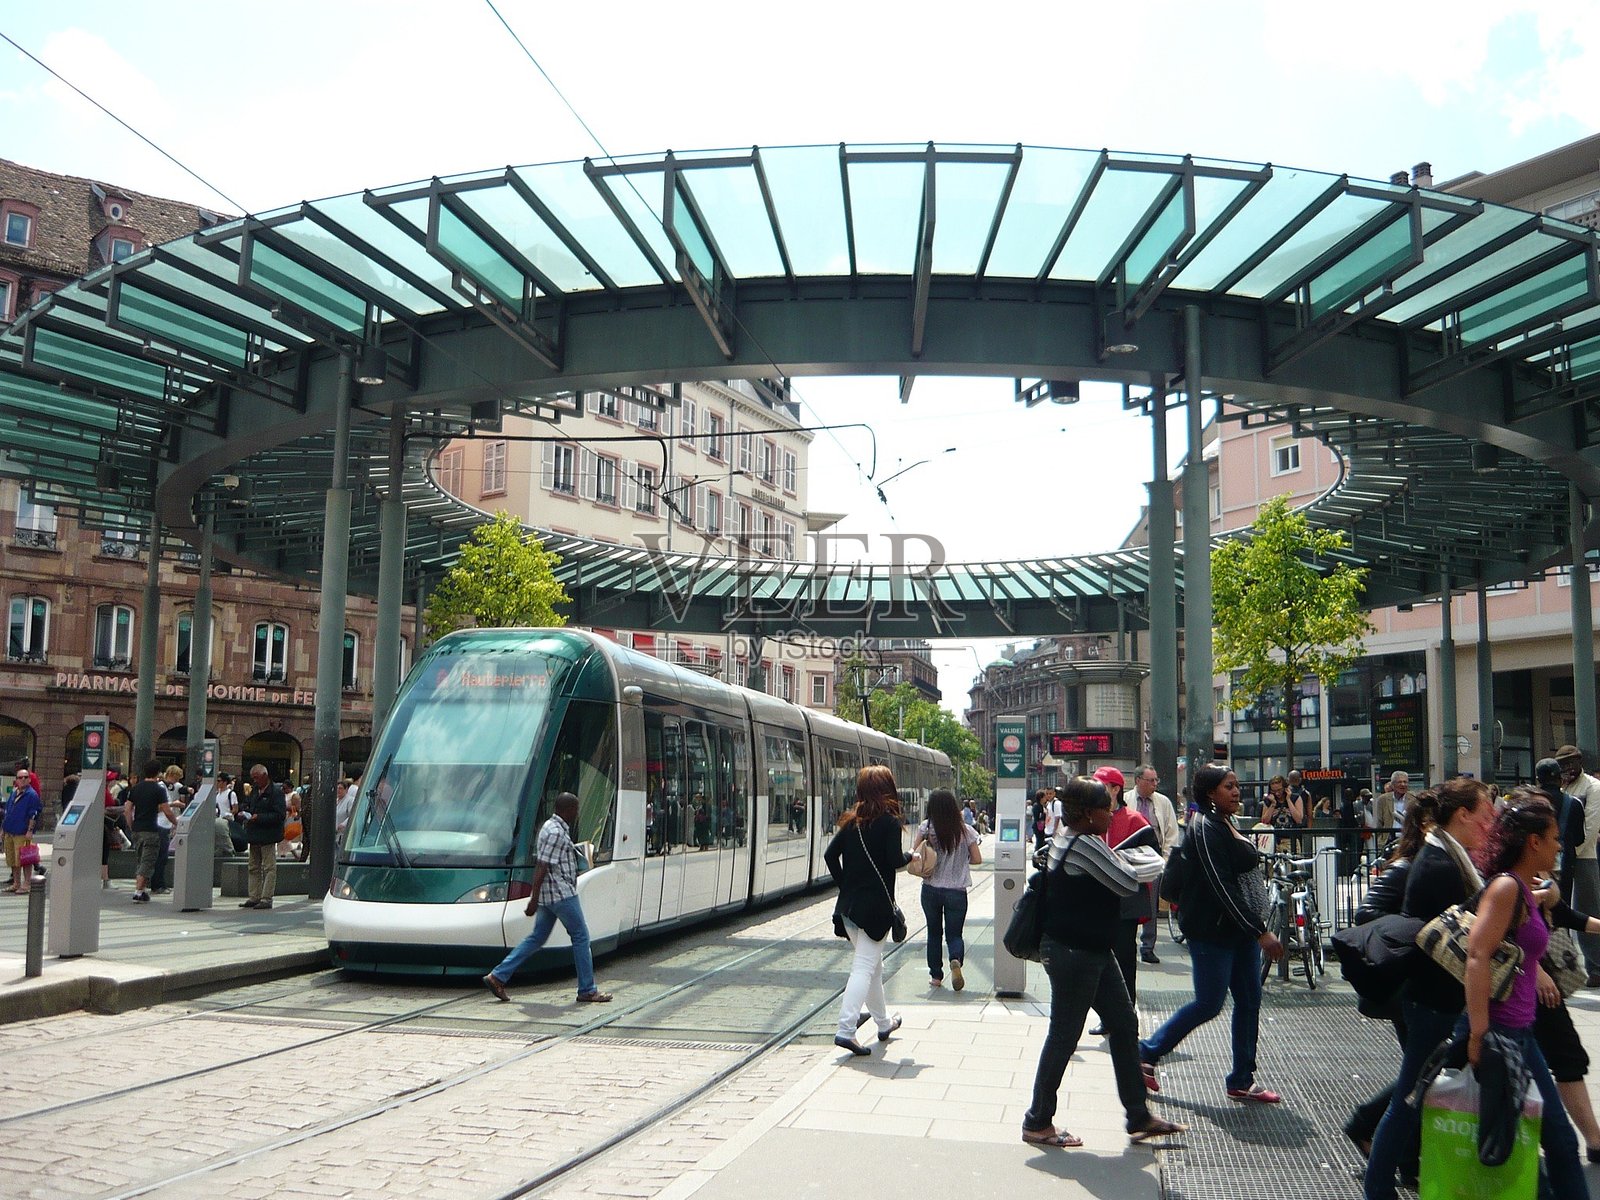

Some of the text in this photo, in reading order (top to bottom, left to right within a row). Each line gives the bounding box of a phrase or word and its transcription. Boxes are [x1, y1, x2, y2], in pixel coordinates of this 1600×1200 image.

[56, 672, 159, 694] PHARMAC
[166, 684, 183, 696] DE
[272, 692, 288, 704] DE
[294, 691, 317, 706] FE
[1301, 769, 1342, 780] Tandem
